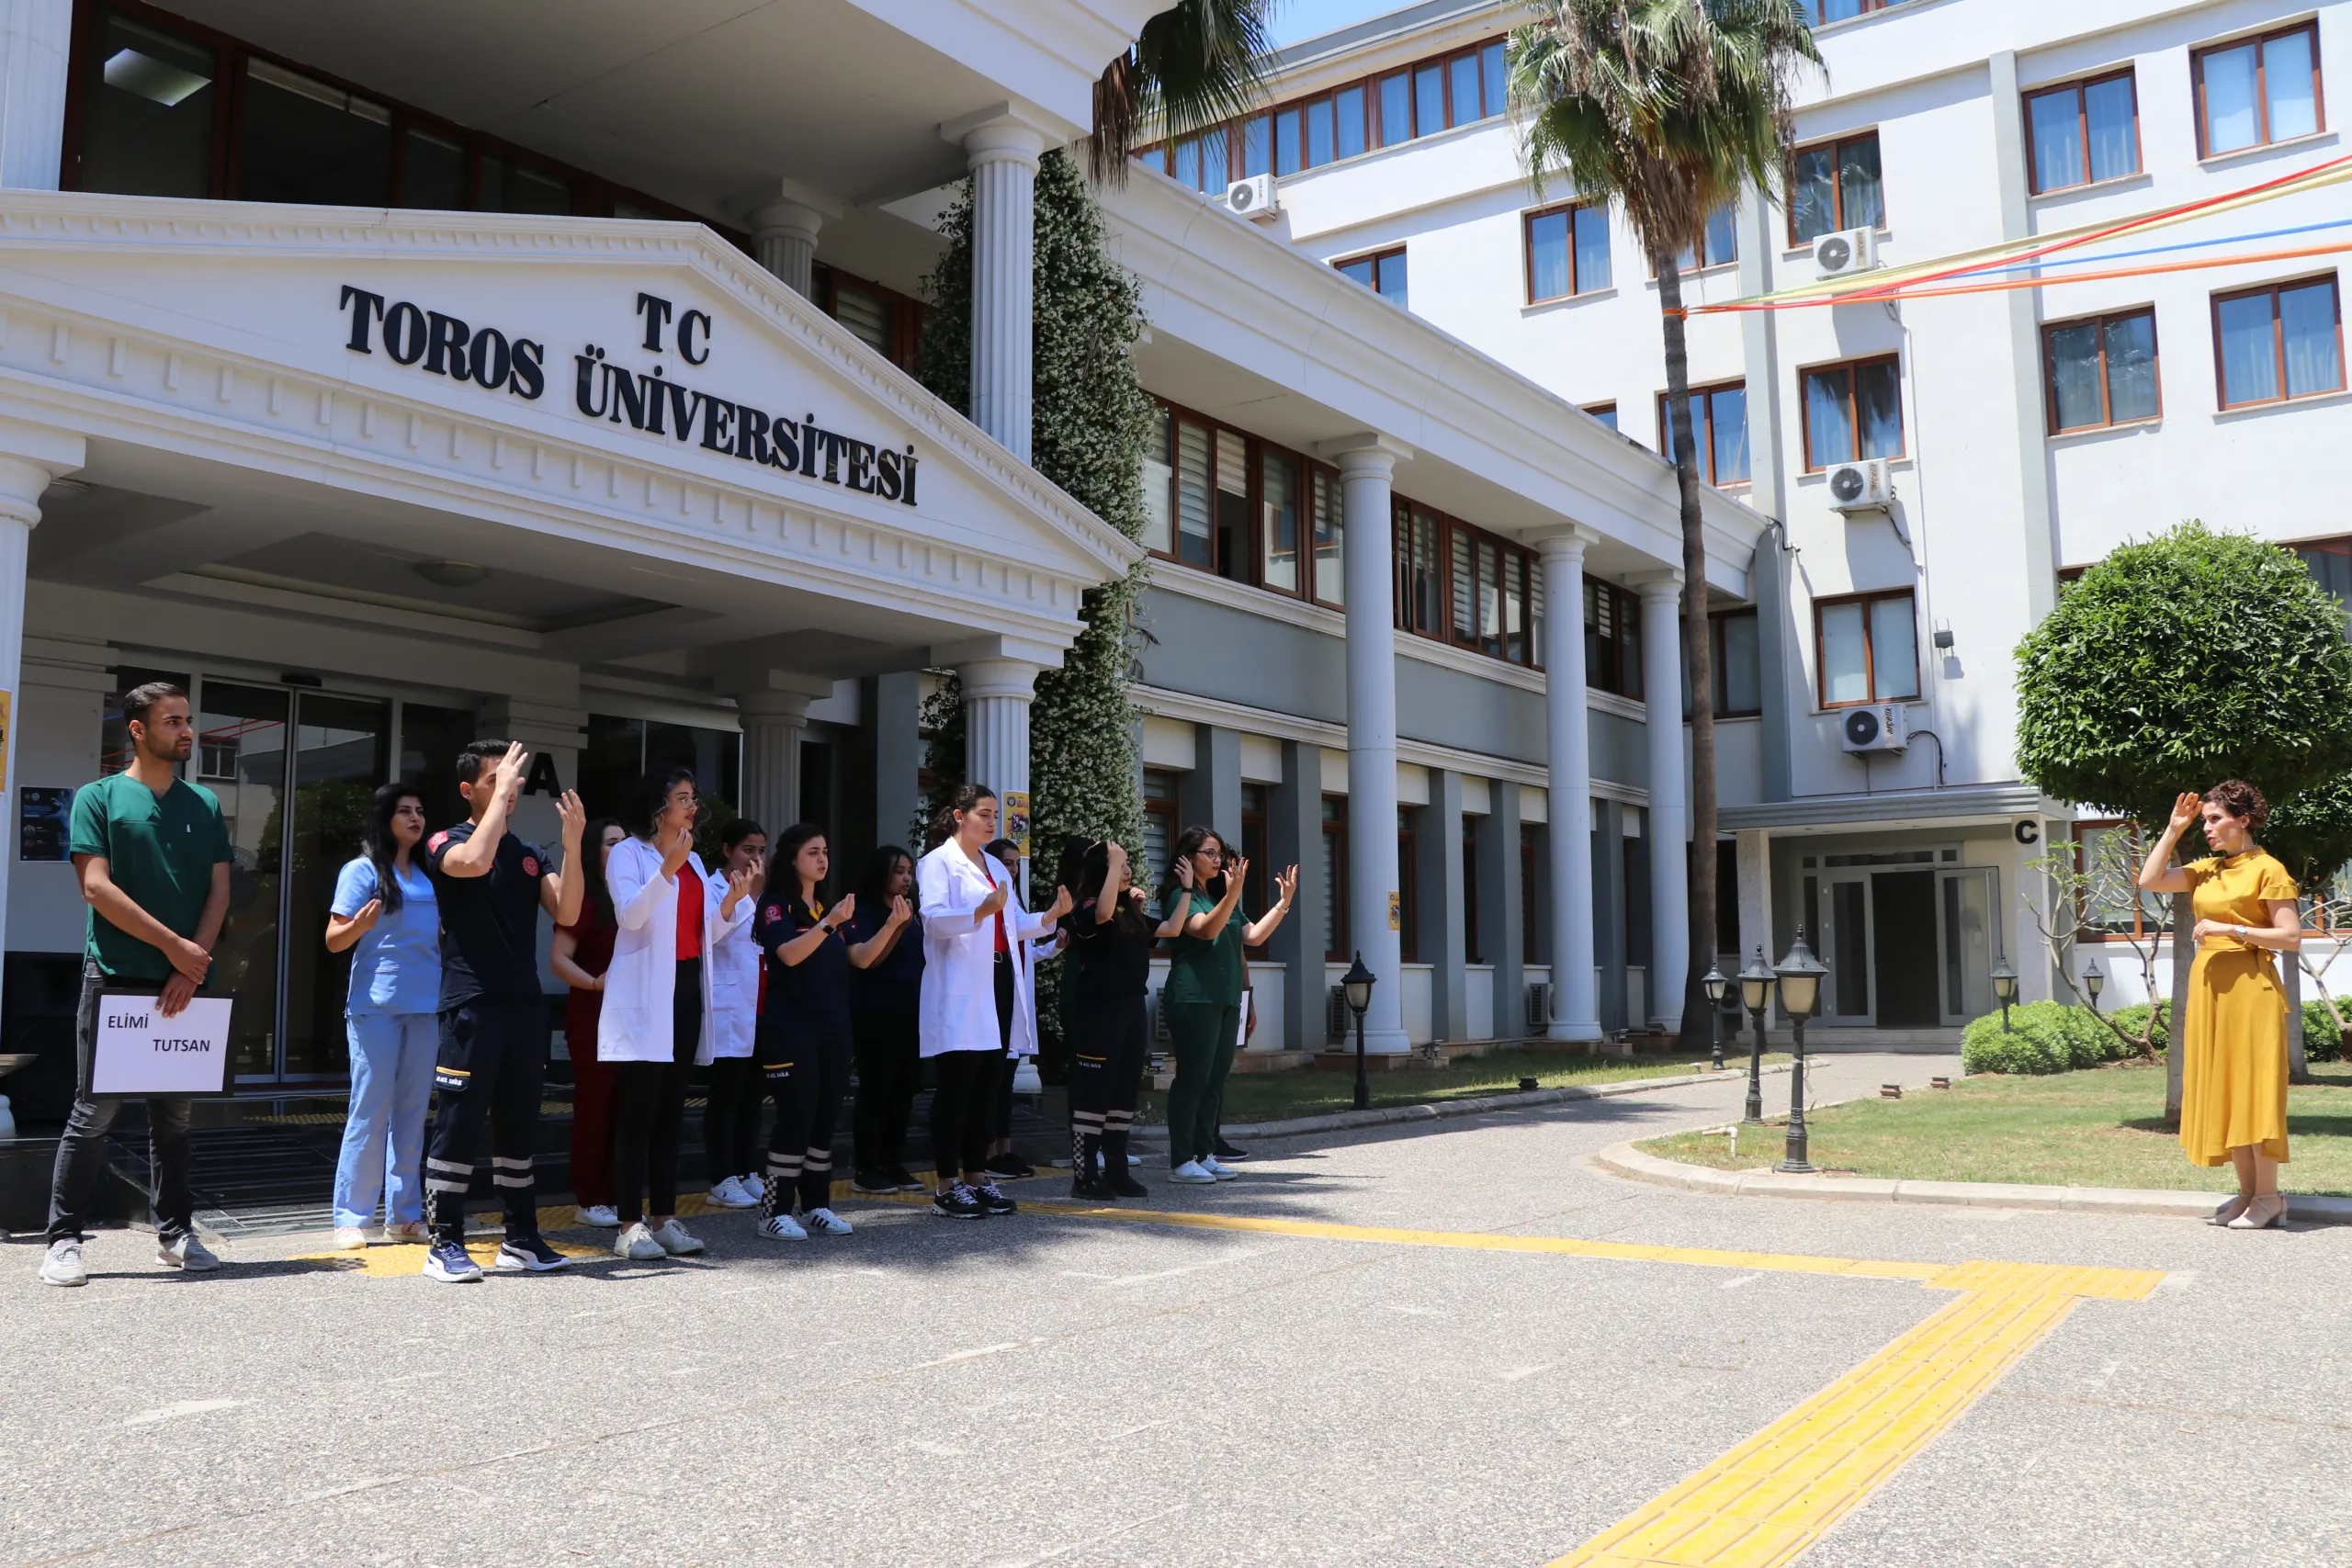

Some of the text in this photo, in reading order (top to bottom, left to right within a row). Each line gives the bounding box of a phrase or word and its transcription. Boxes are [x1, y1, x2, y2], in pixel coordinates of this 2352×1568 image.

[339, 284, 918, 506] TOROS ÜNİVERSİTESİ
[521, 751, 563, 799] A
[2015, 820, 2039, 844] C
[107, 1013, 149, 1029] ELİMİ
[153, 1039, 210, 1052] TUTSAN
